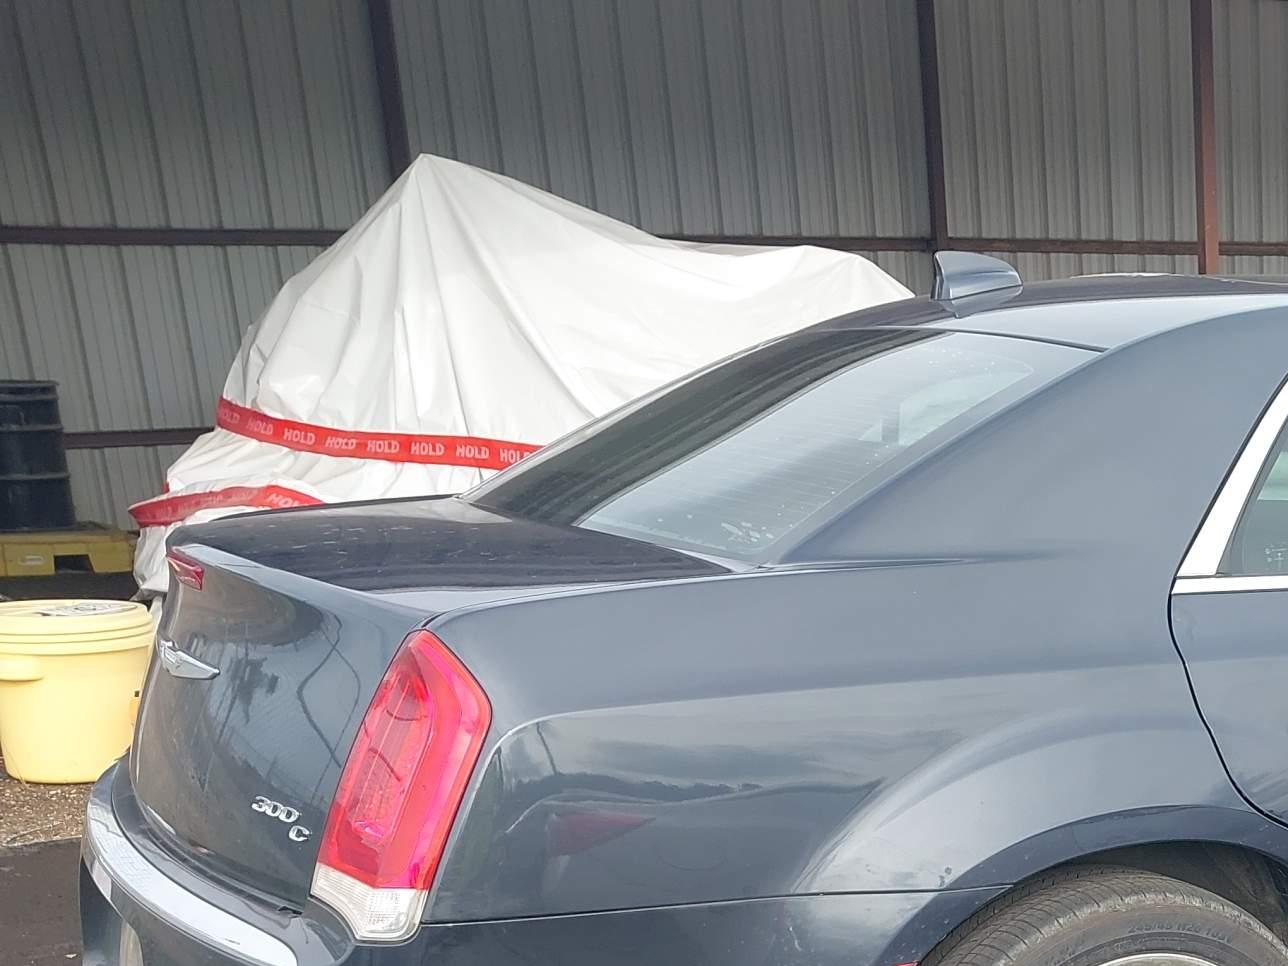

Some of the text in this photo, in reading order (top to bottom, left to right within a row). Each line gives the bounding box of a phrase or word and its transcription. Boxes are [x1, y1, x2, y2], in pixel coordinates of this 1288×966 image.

[284, 428, 315, 446] HOLD
[325, 436, 357, 450] HOLD
[367, 440, 399, 453] HOLD
[410, 441, 444, 456] HOLD
[456, 444, 490, 459] HOLD
[252, 796, 299, 822] 300
[289, 825, 310, 842] C
